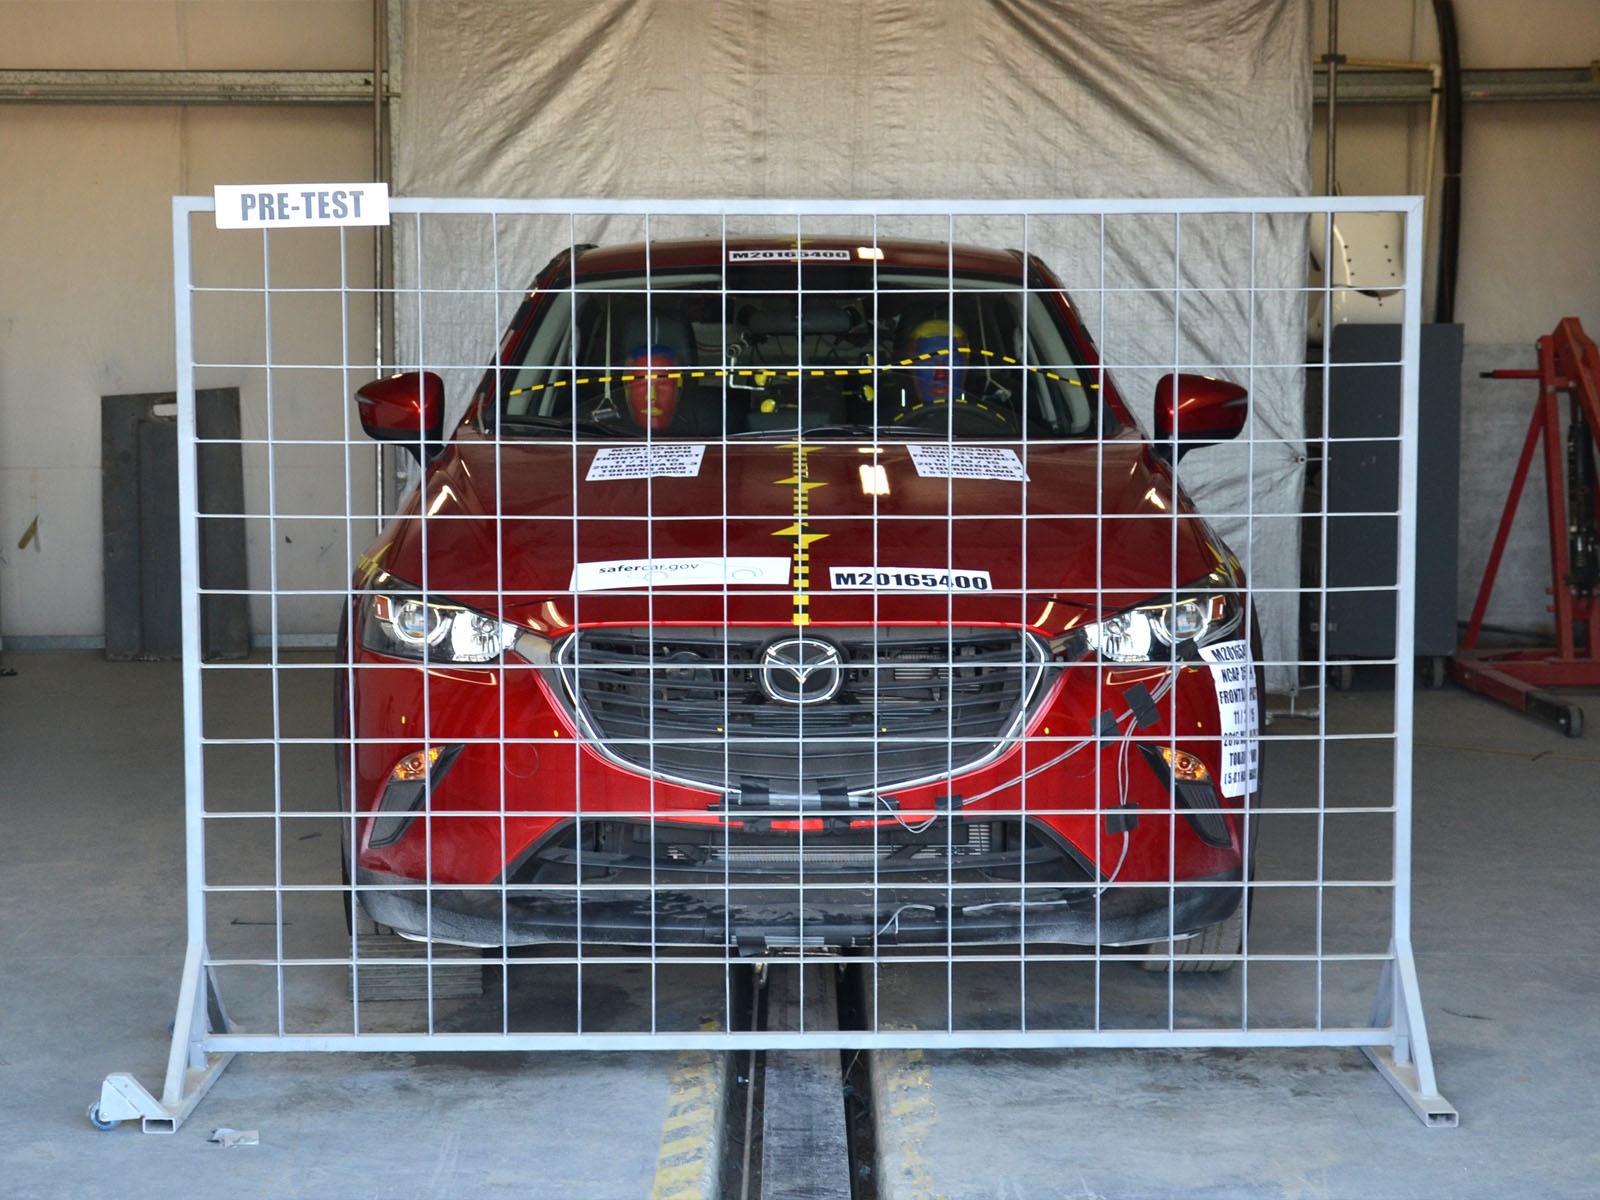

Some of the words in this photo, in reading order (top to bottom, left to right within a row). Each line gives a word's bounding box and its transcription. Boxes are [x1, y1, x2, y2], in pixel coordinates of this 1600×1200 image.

[241, 190, 364, 221] PRE-TEST
[732, 251, 847, 259] M20165400
[599, 562, 699, 574] safercar.gov
[835, 572, 988, 590] M20165400
[1221, 667, 1240, 683] NCAP
